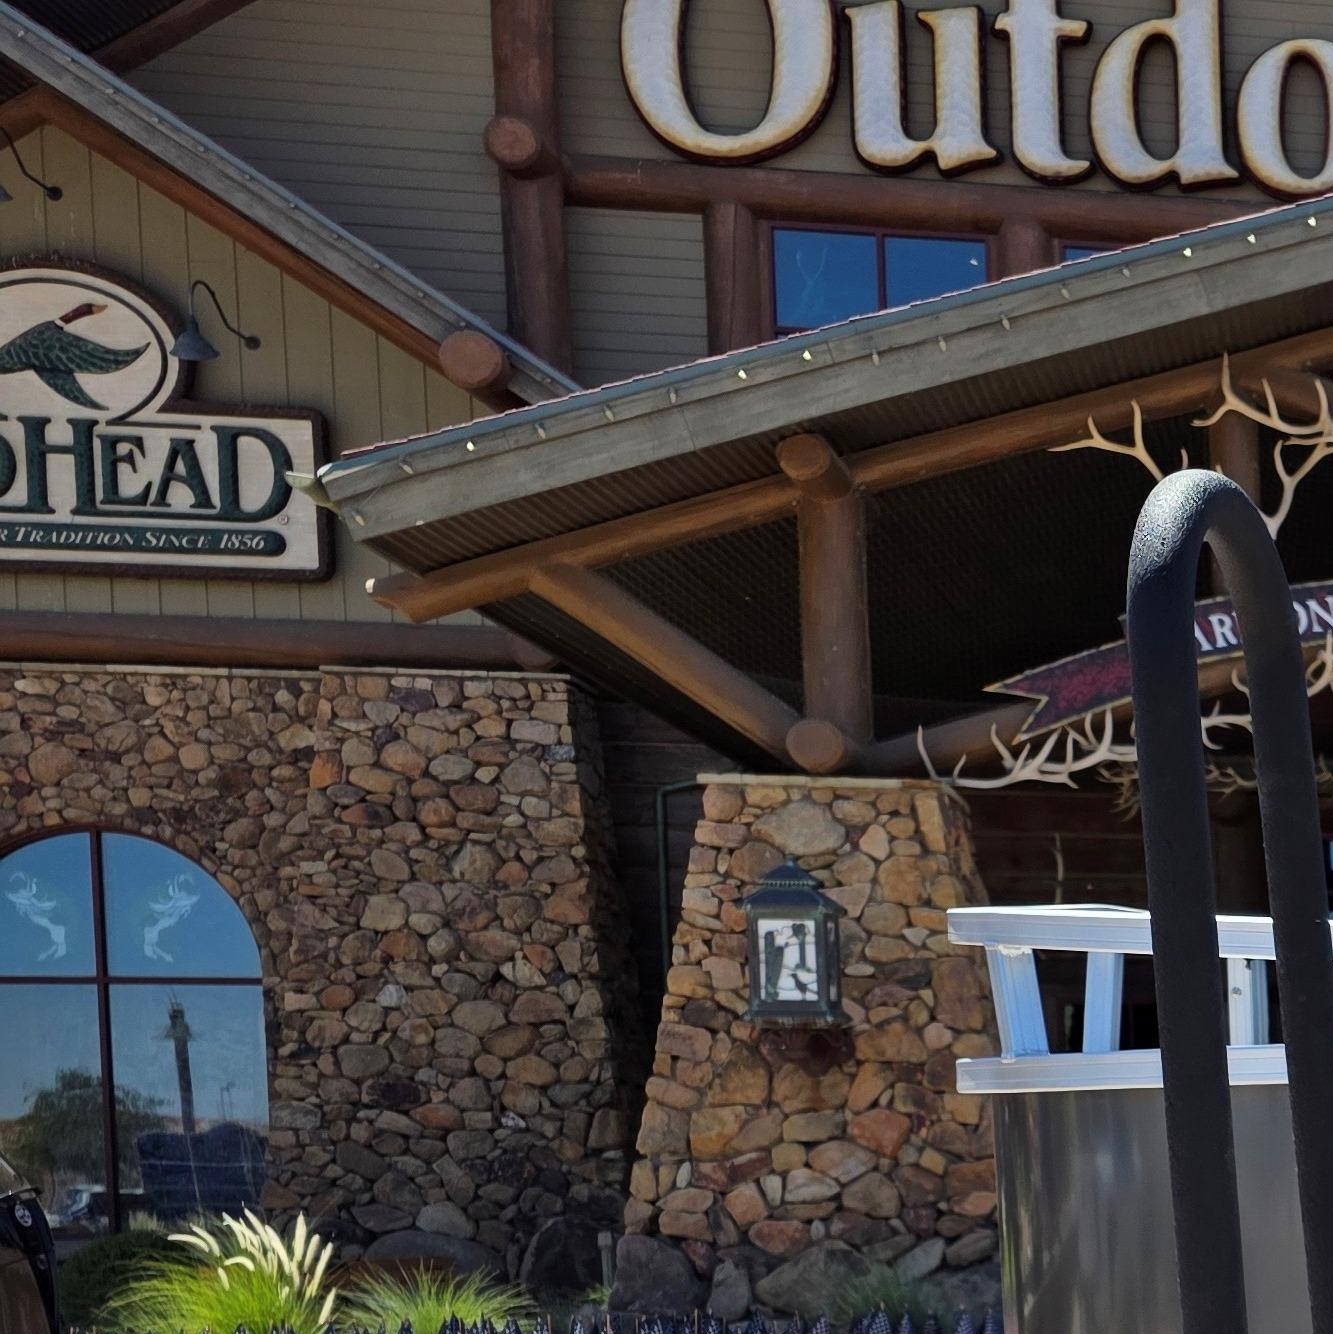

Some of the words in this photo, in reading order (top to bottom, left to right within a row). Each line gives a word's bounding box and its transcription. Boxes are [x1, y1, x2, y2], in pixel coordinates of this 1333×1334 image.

[0, 415, 294, 523] HEAD
[15, 526, 137, 547] TRADITION
[142, 531, 212, 550] SINCE
[219, 532, 266, 551] 1856
